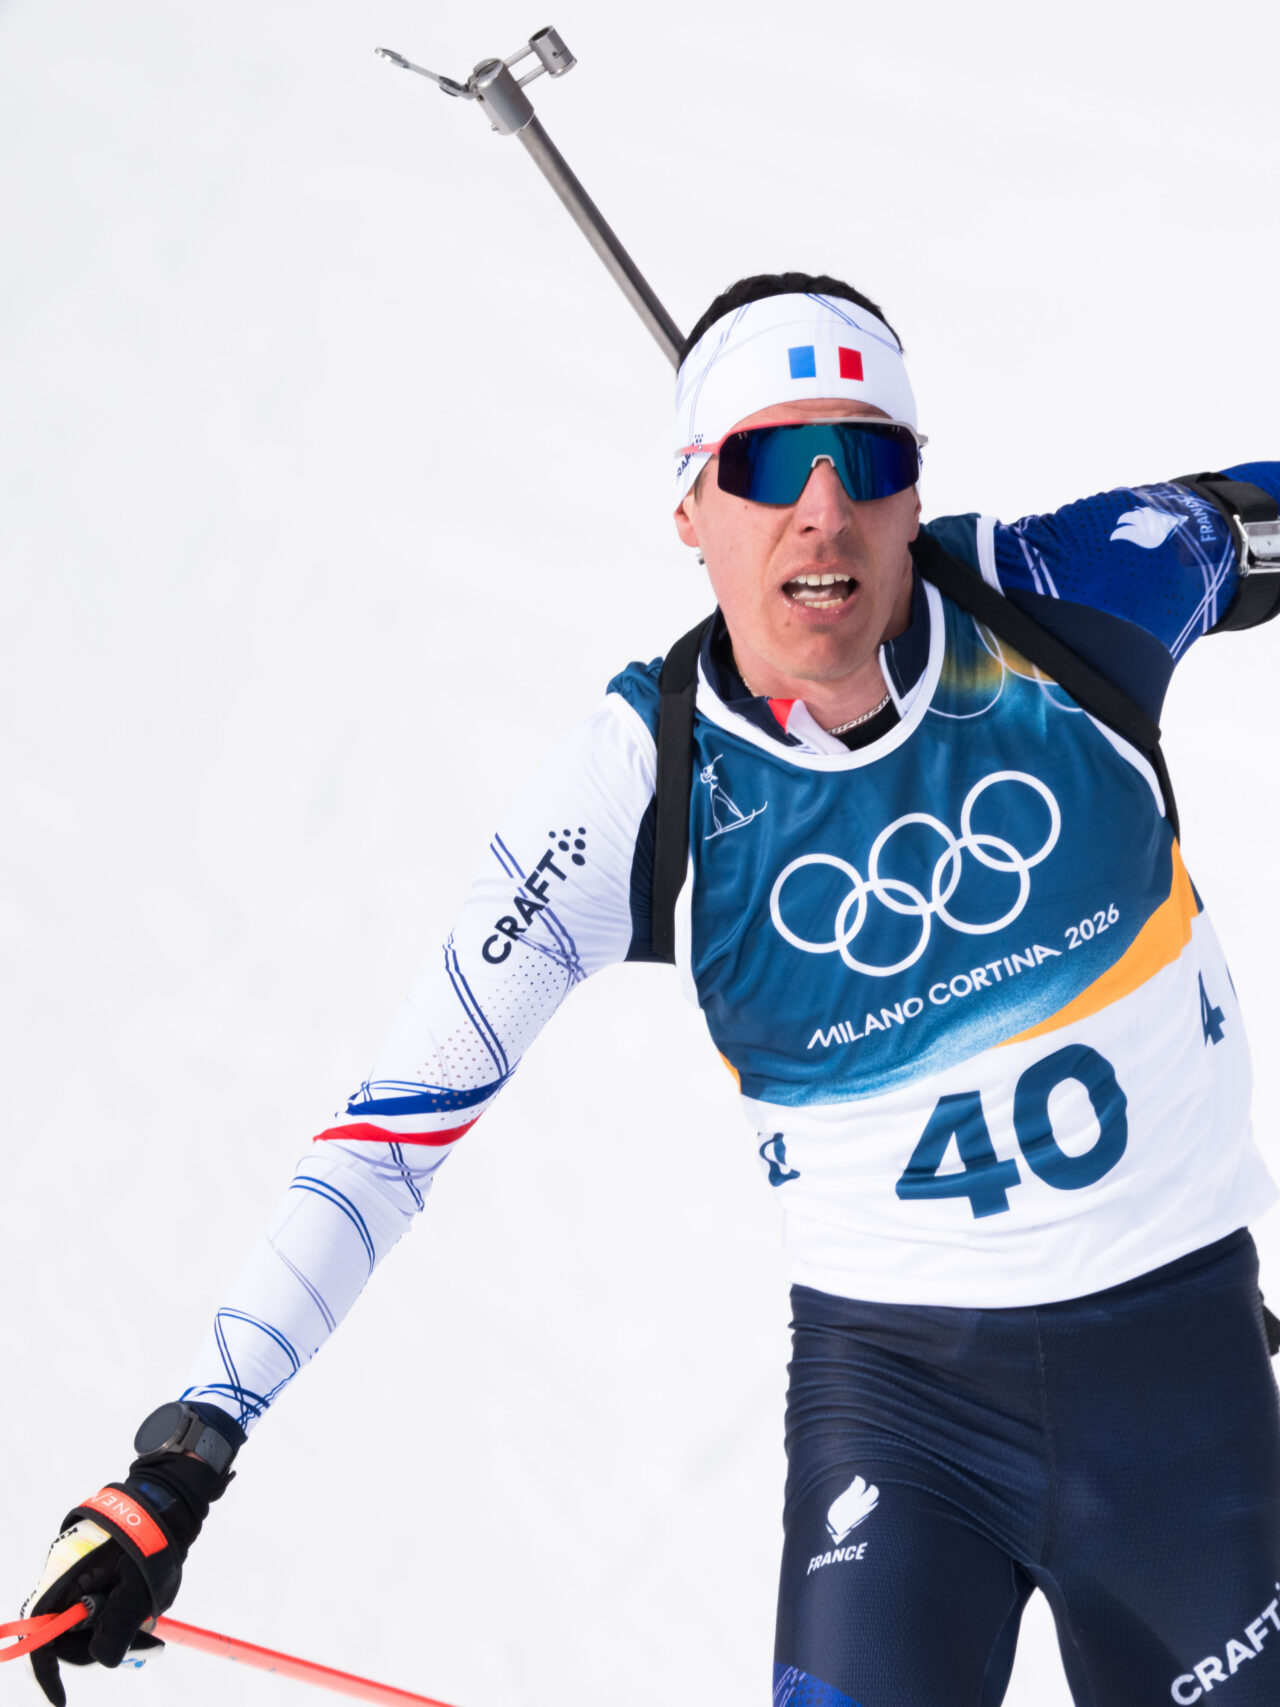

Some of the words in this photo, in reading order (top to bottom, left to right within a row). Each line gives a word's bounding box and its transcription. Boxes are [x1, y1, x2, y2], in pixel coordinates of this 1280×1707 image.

[482, 848, 567, 965] CRAFT
[806, 997, 924, 1050] MILANO
[928, 944, 1063, 1006] CORTINA
[1064, 903, 1120, 950] 2026
[895, 1043, 1129, 1220] 40
[807, 1542, 868, 1576] FRANCE
